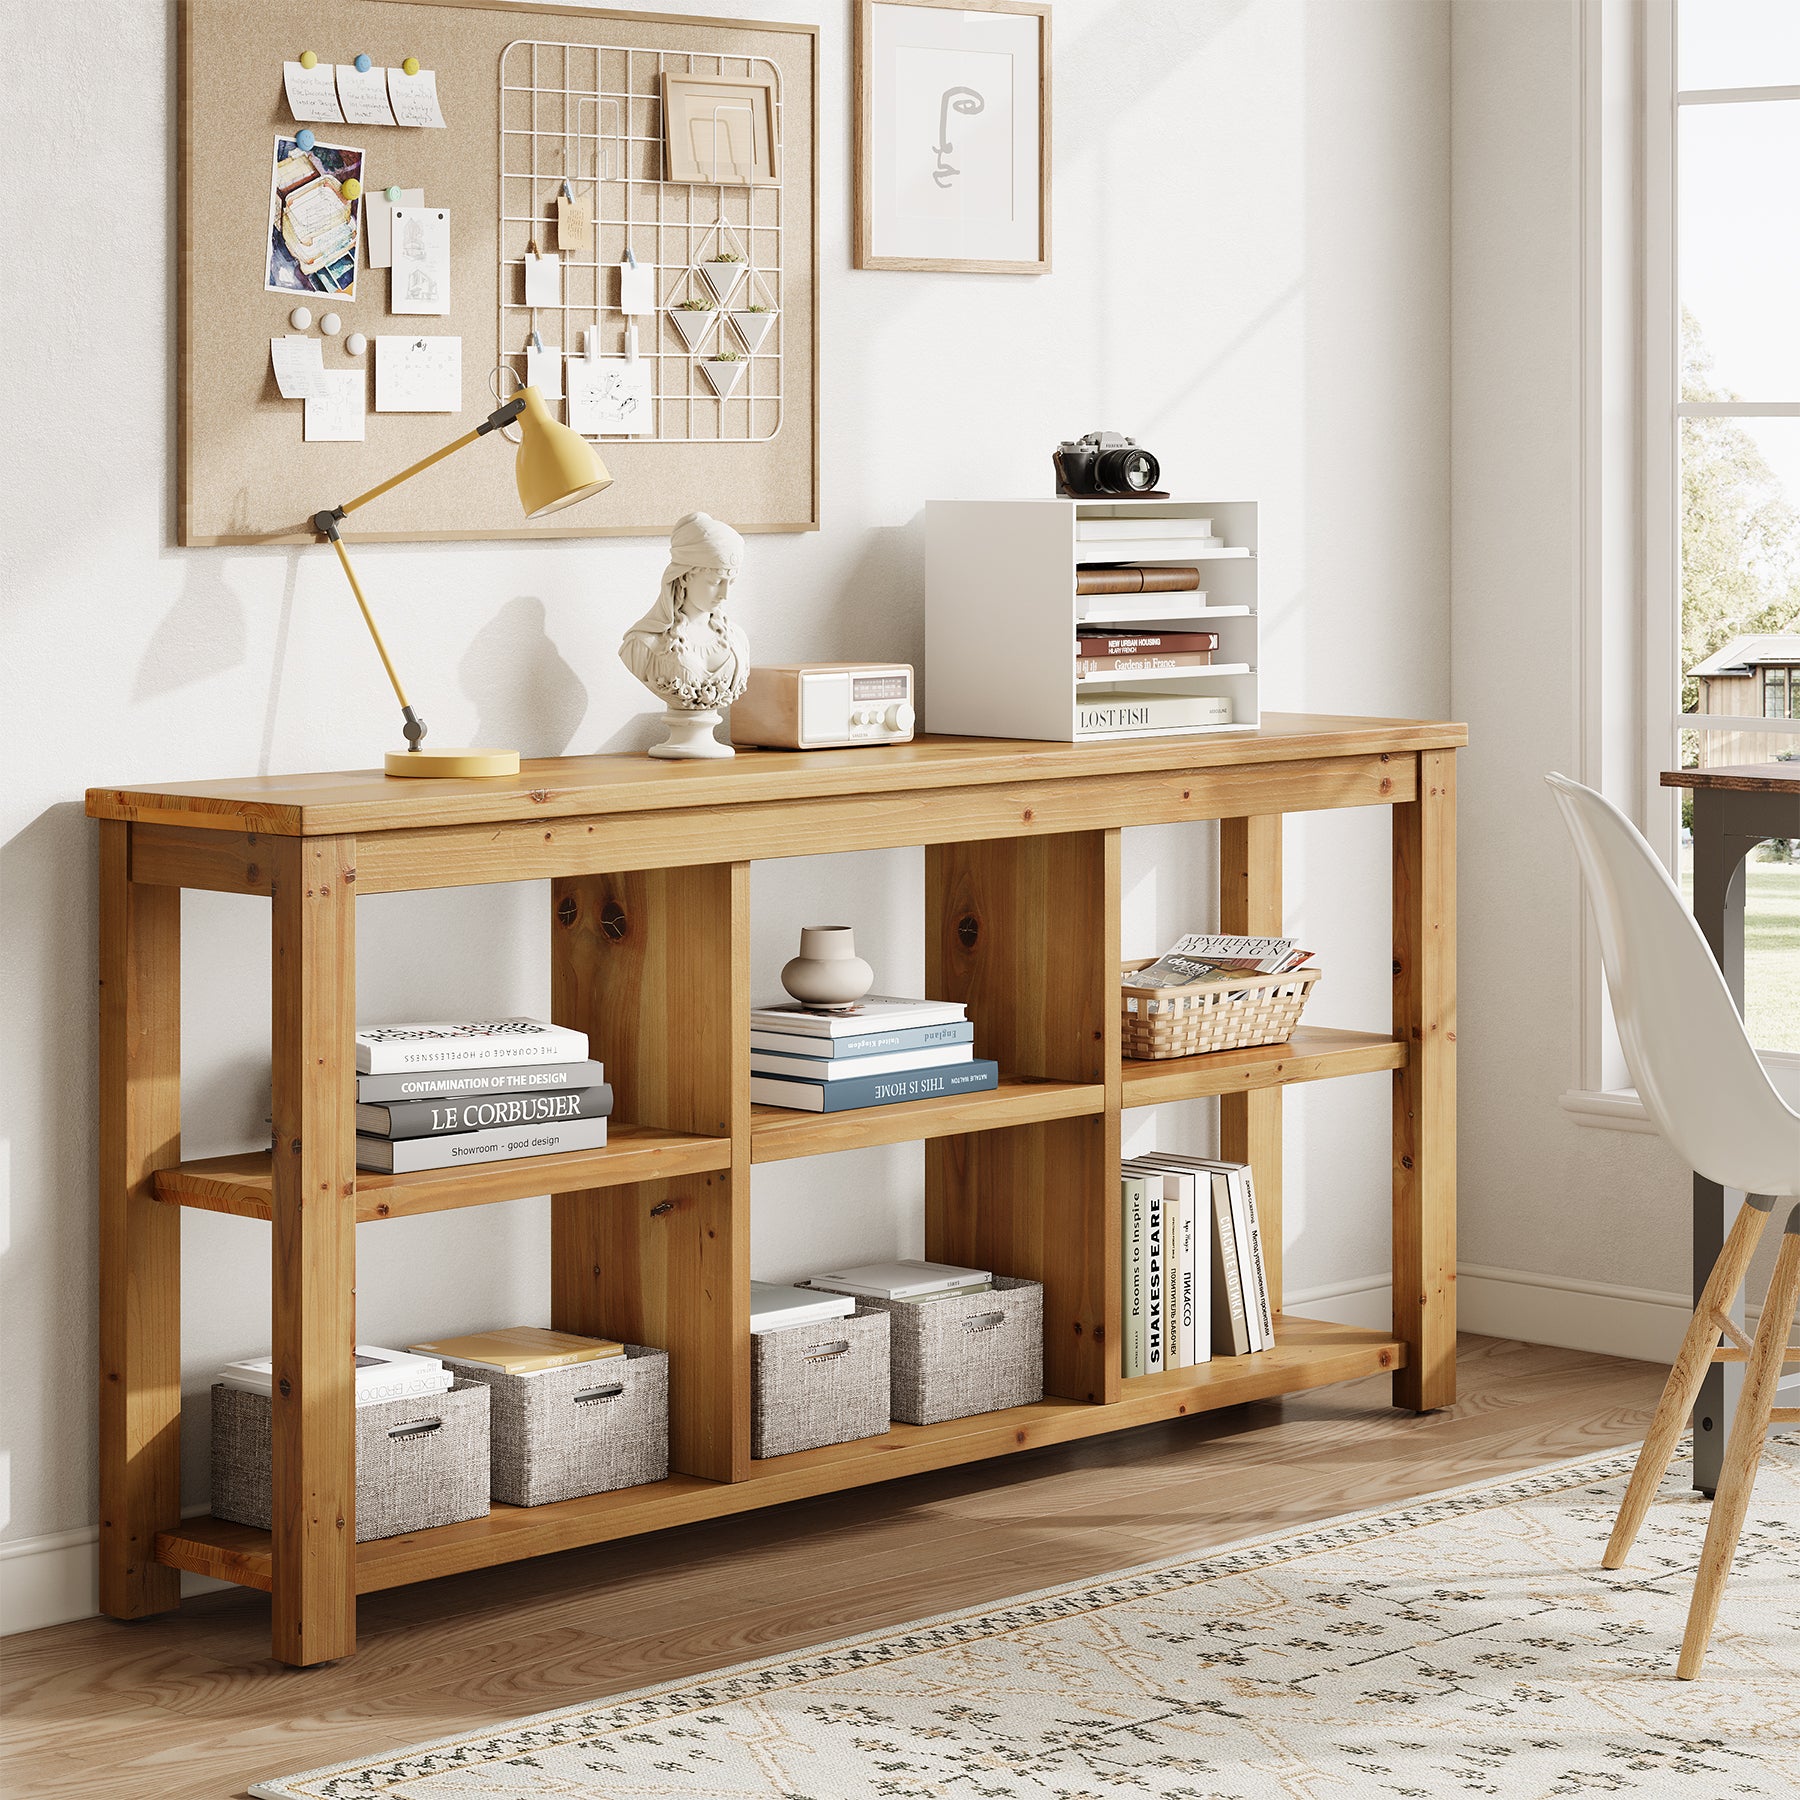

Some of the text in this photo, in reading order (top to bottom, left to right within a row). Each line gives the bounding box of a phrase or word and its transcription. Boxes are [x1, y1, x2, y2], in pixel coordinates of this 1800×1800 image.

[1108, 638, 1161, 648] NEW URBAN HOUSING
[1115, 657, 1176, 671] Gardens in France
[1080, 707, 1149, 728] LOST FISH
[1182, 944, 1284, 956] DESIGN
[1167, 957, 1213, 971] domus
[847, 1036, 900, 1050] United Kingdom
[924, 1029, 957, 1042] England
[404, 1046, 557, 1063] THE COURAGE OF HOPELESSNESS
[401, 1072, 567, 1093] CONTAMINATION OF THE DESIGN
[875, 1077, 945, 1099] THIS IS HOME
[431, 1094, 582, 1130] LE CORBUSIER
[451, 1143, 499, 1157] Showroom
[507, 1139, 529, 1152] good
[531, 1136, 560, 1150] design
[1132, 1192, 1142, 1316] Rooms to Inspire
[1219, 1215, 1243, 1320] СПАСИТЕ КОТИКА!
[1150, 1198, 1160, 1363] SHAKESPEARE
[1251, 1230, 1271, 1337] Метод управления проектами
[1183, 1272, 1191, 1327] ПИКАССО
[405, 1374, 450, 1394] ALEXEY
